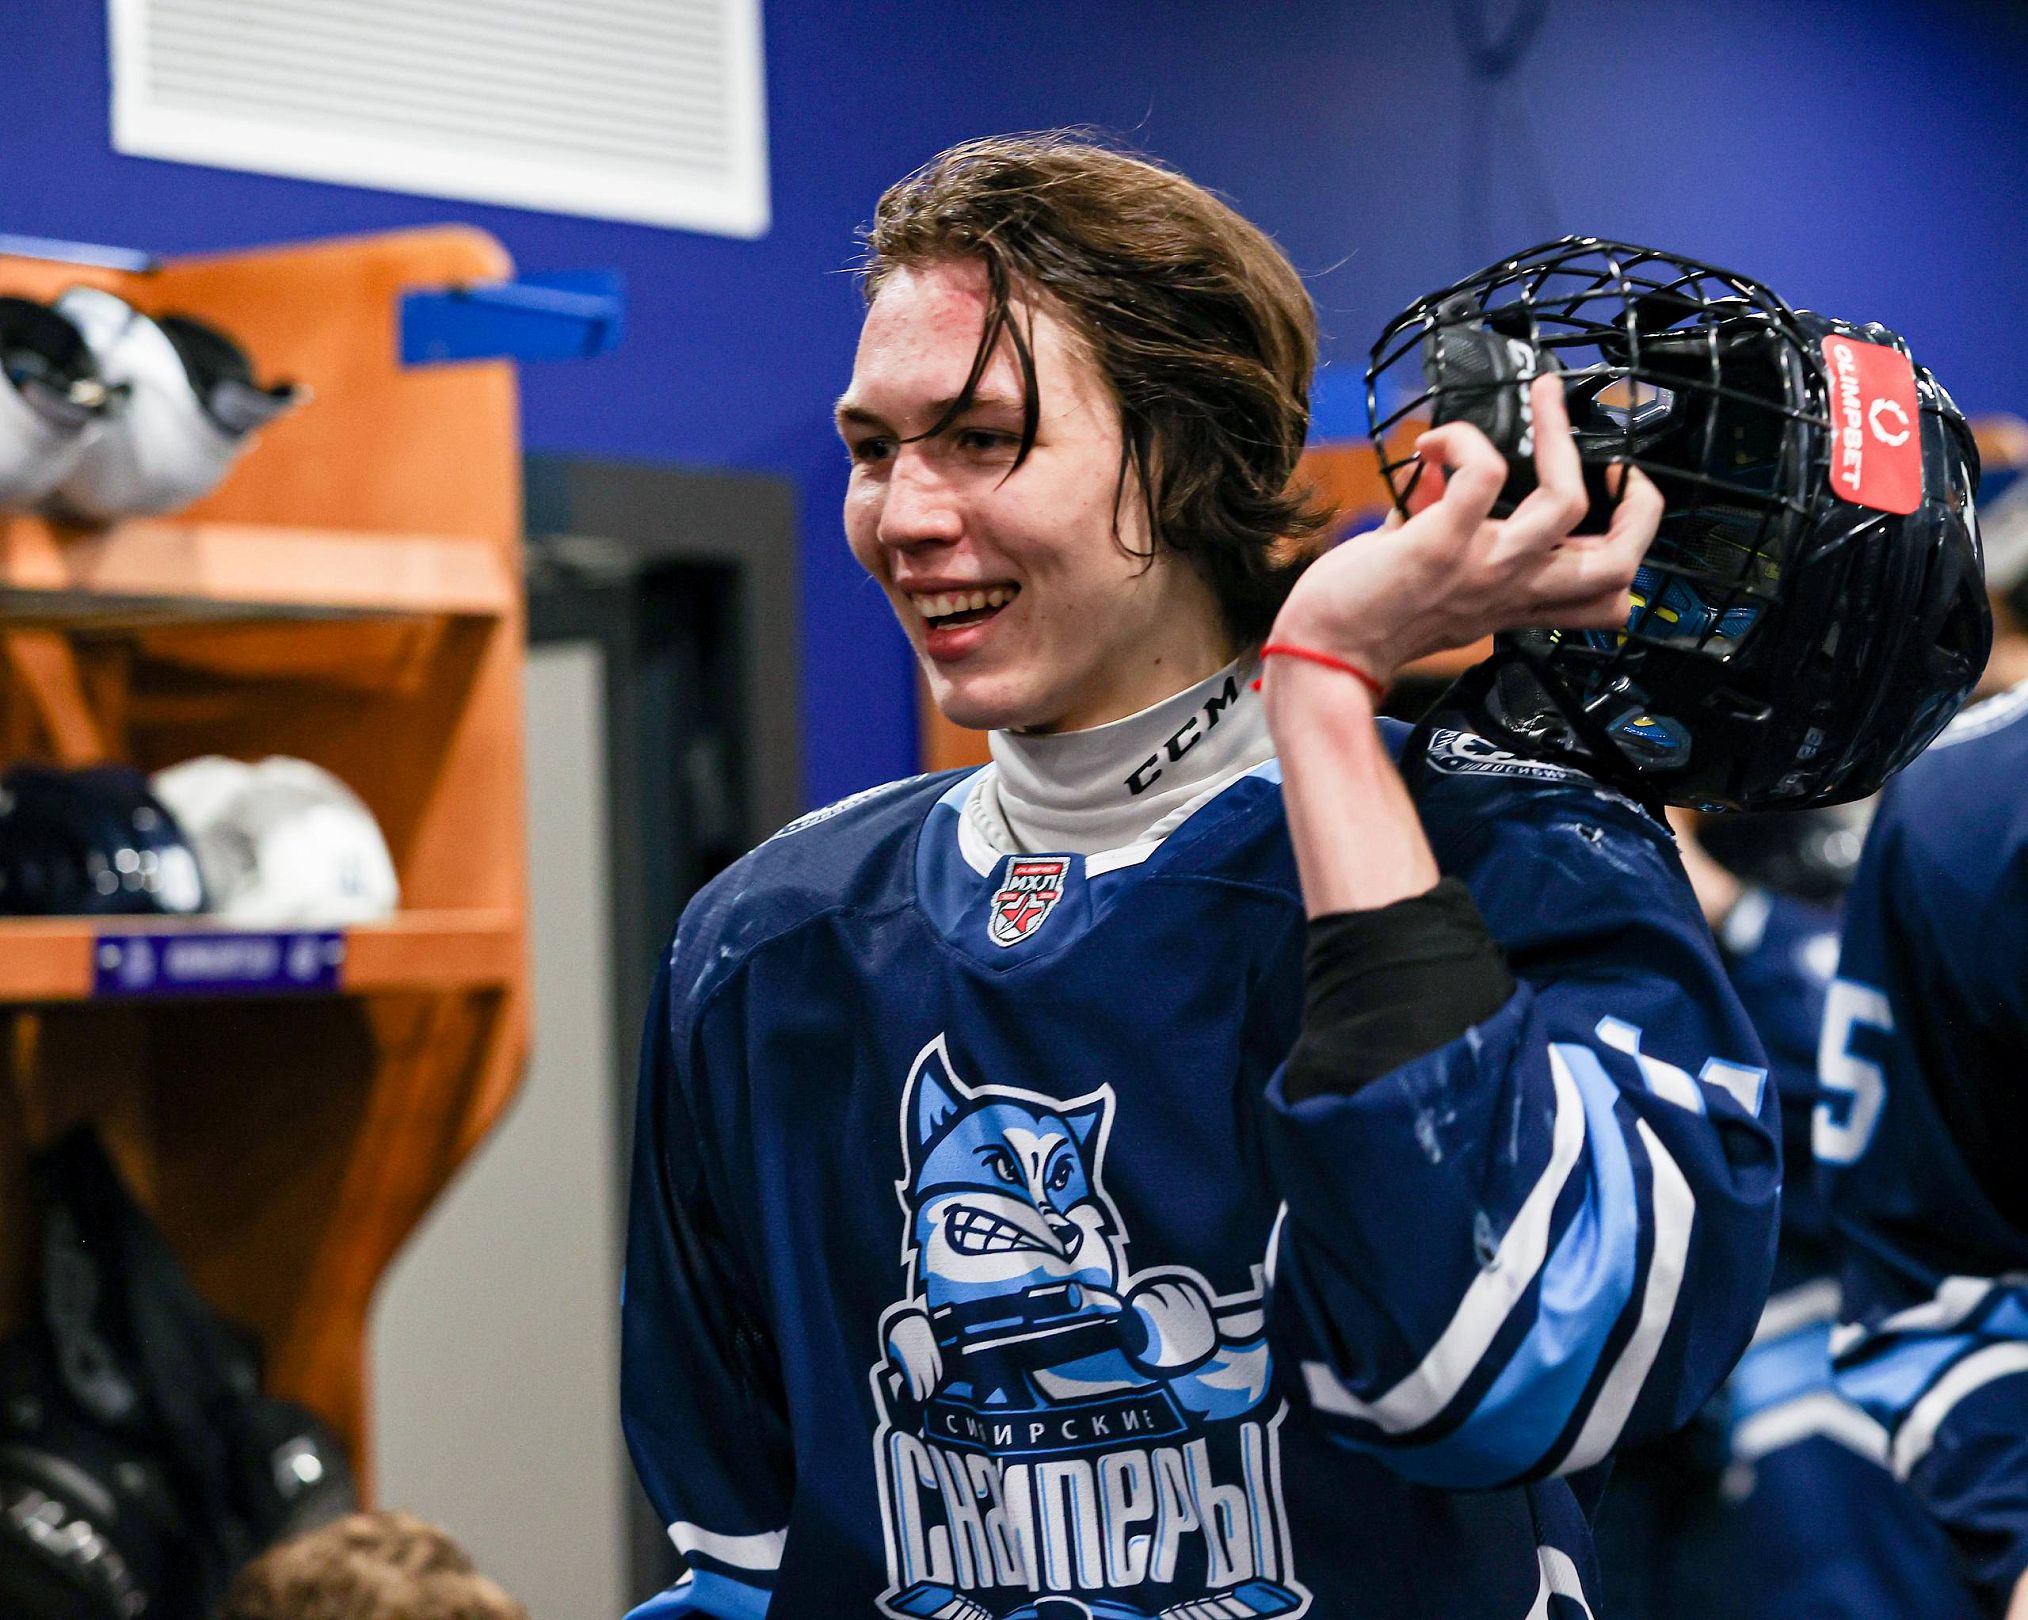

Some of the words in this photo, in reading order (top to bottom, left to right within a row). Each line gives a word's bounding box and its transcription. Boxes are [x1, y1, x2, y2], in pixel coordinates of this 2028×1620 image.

[1833, 344, 1863, 491] OLIMPBET
[1124, 676, 1238, 795] CCM
[1811, 978, 1895, 1165] 5
